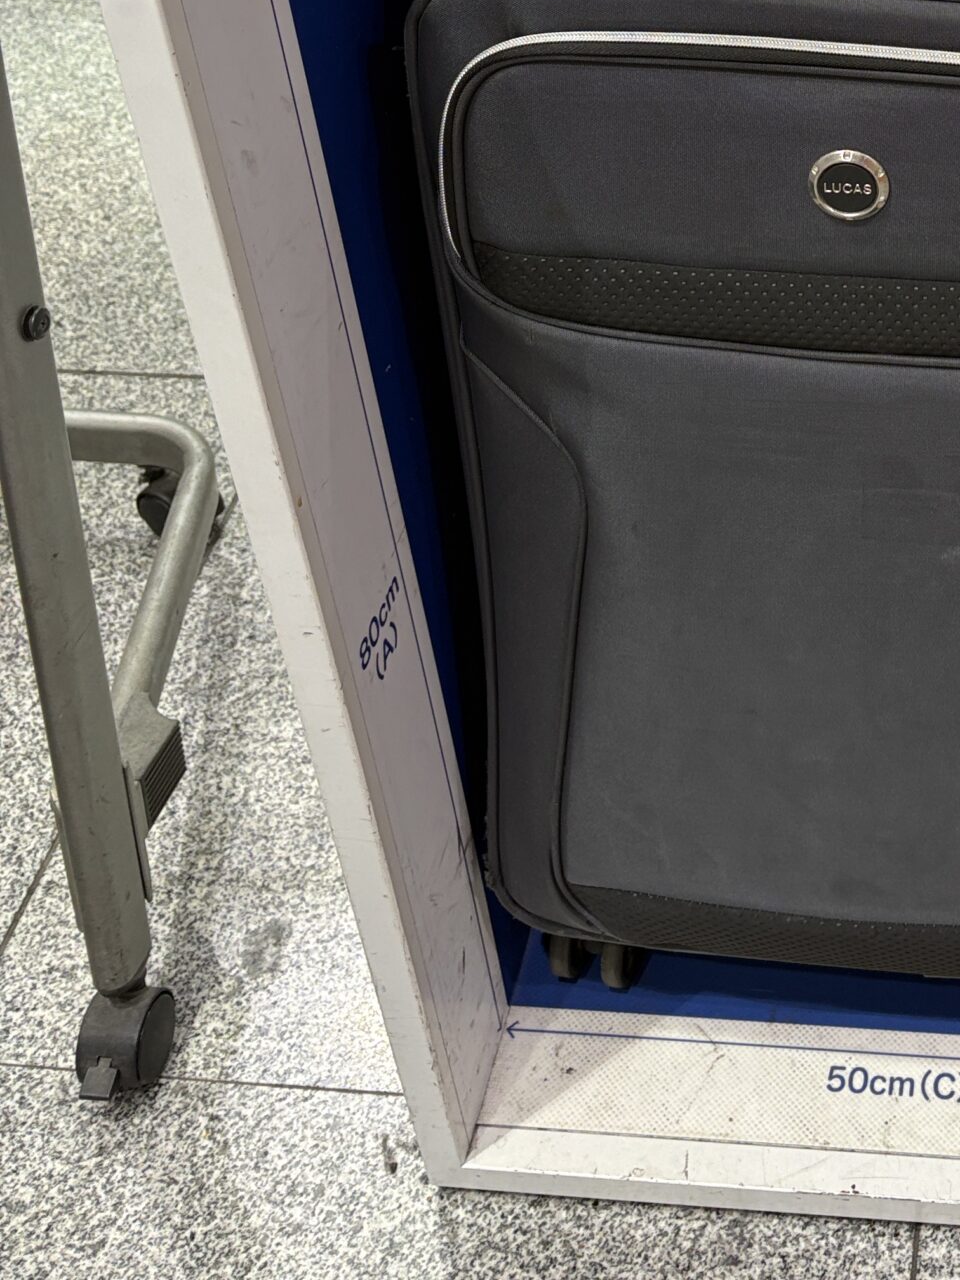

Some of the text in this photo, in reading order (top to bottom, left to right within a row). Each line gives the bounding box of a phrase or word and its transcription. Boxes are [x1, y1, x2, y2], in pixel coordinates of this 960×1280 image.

[823, 182, 872, 195] LUCAS
[359, 575, 400, 671] 80cm
[375, 621, 398, 681] (A)
